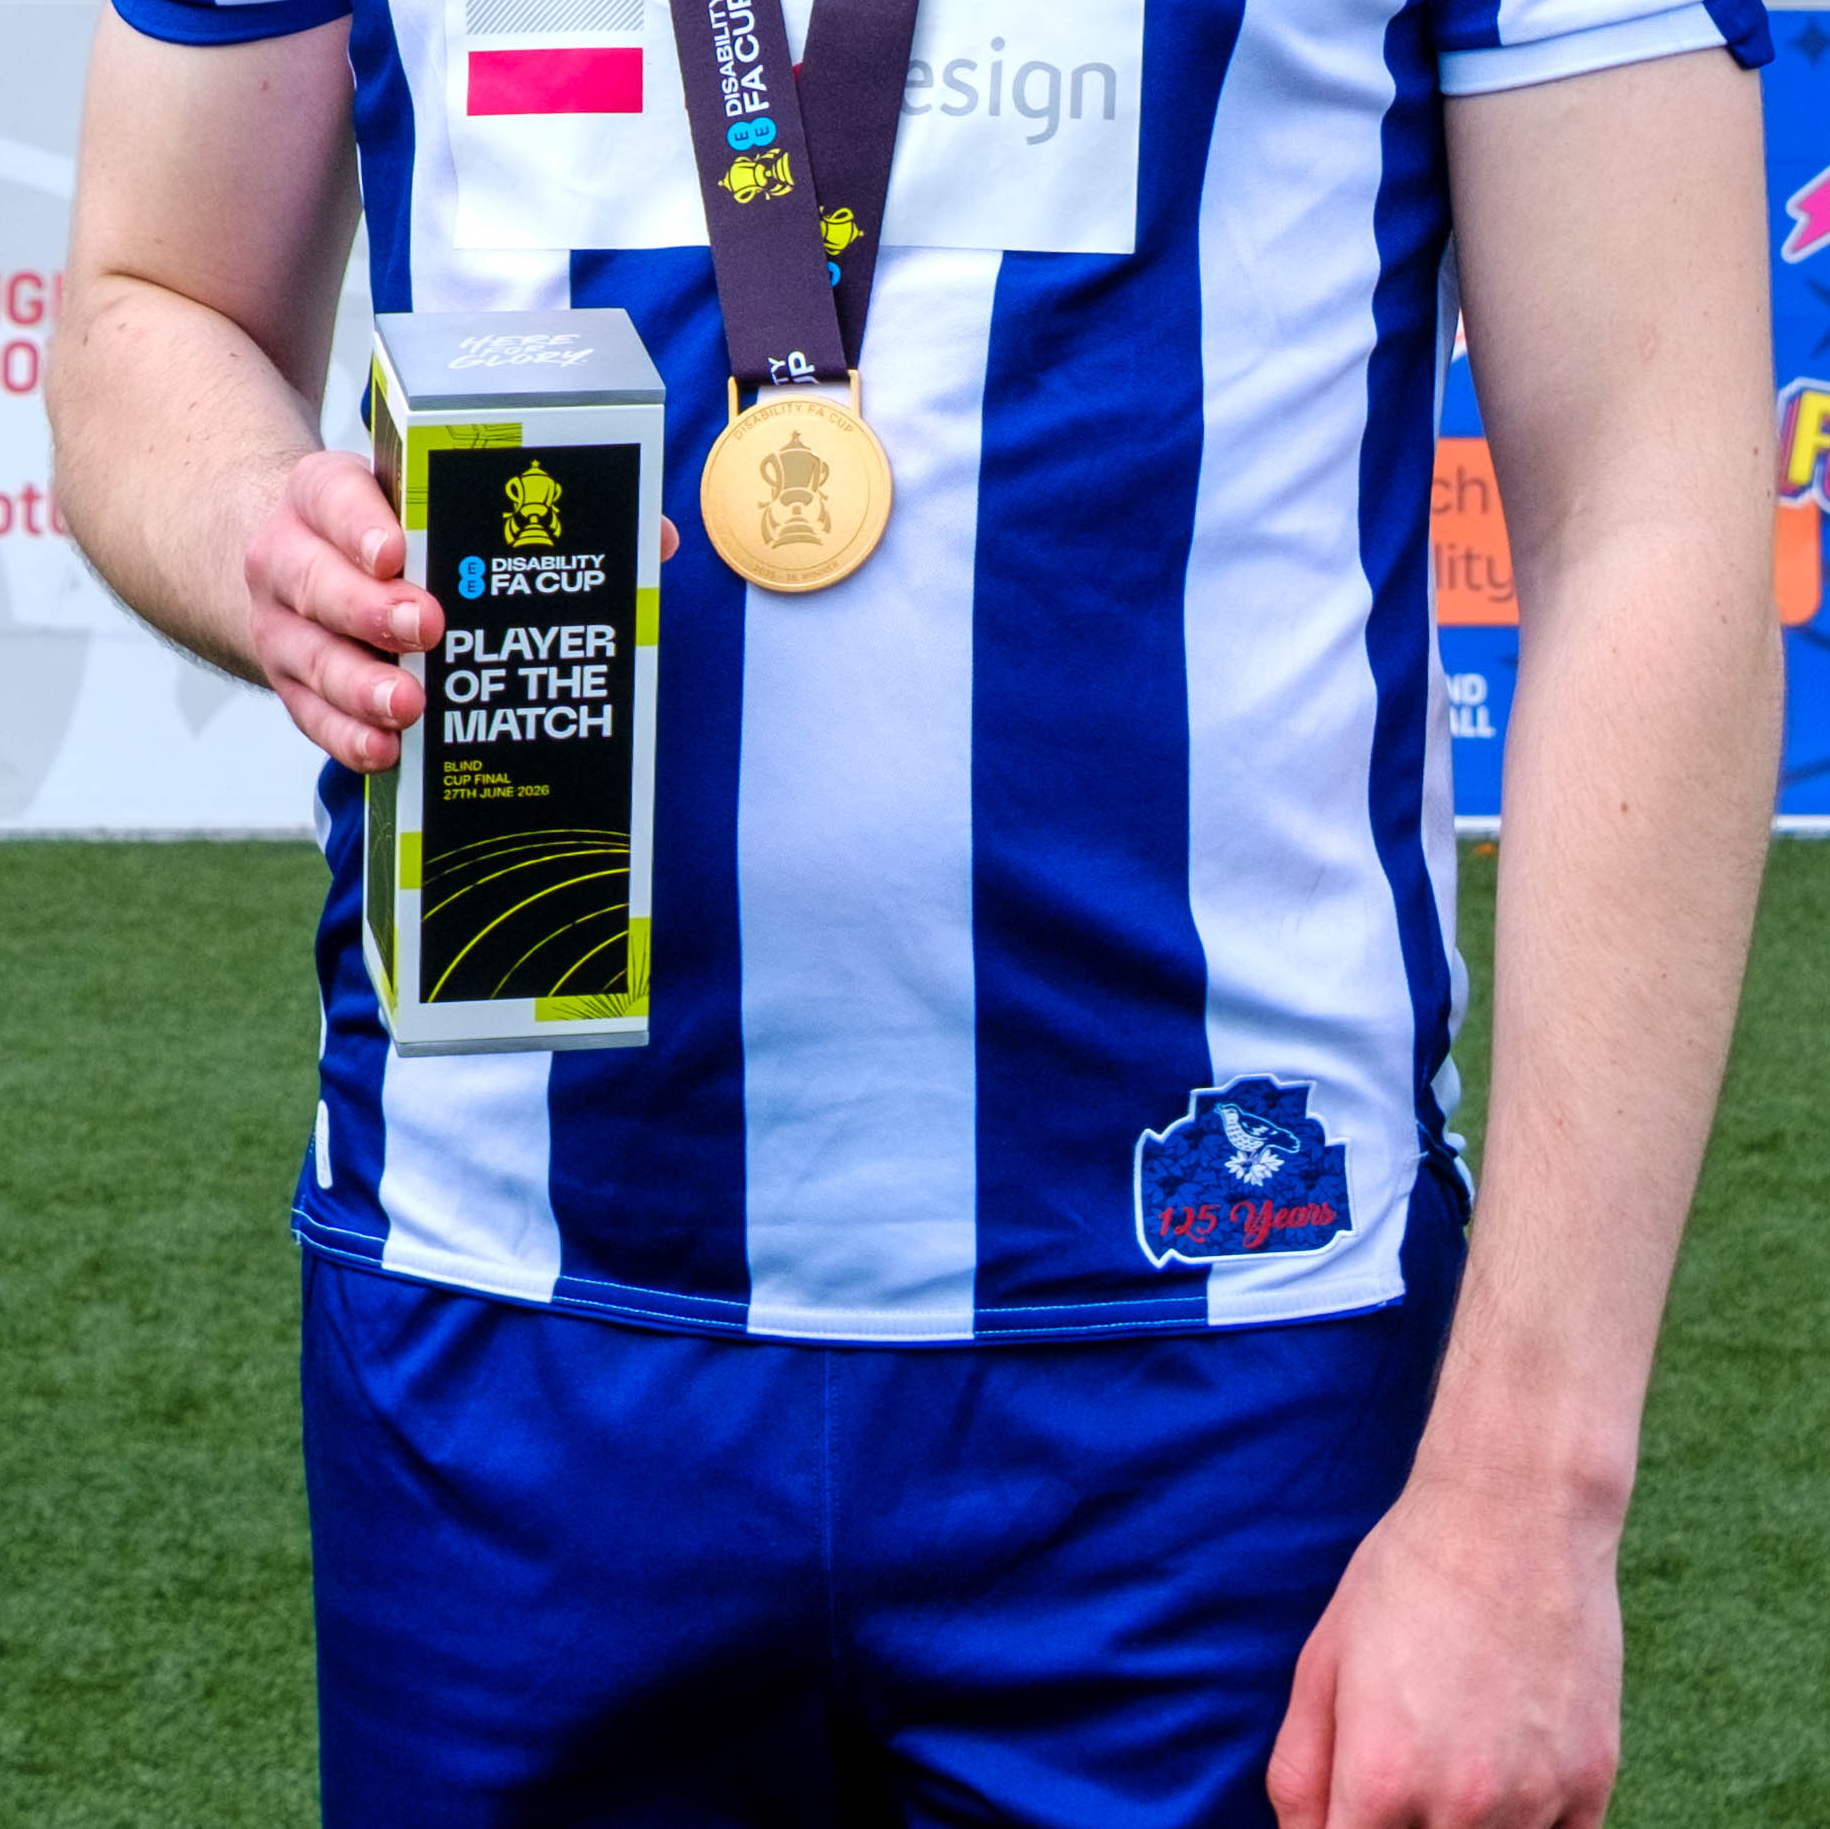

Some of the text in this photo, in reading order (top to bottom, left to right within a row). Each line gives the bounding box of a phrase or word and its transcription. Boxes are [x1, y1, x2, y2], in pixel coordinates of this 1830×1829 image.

[743, 65, 770, 113] FA
[459, 334, 579, 353] HERE
[479, 345, 546, 357] FOR
[448, 349, 595, 370] GLORY.
[734, 404, 854, 440] DISABILITY FA CUP
[491, 554, 606, 573] DISABILITY
[491, 572, 606, 596] FA CUP
[444, 624, 616, 664] PLAYER
[444, 665, 608, 703] OF THE
[444, 705, 612, 744] MATCH
[443, 760, 483, 772] BLIND
[443, 773, 511, 786] CUP FINAL
[443, 785, 550, 800] 27TH JUNE 2026
[1158, 1199, 1336, 1249] 125 Years
